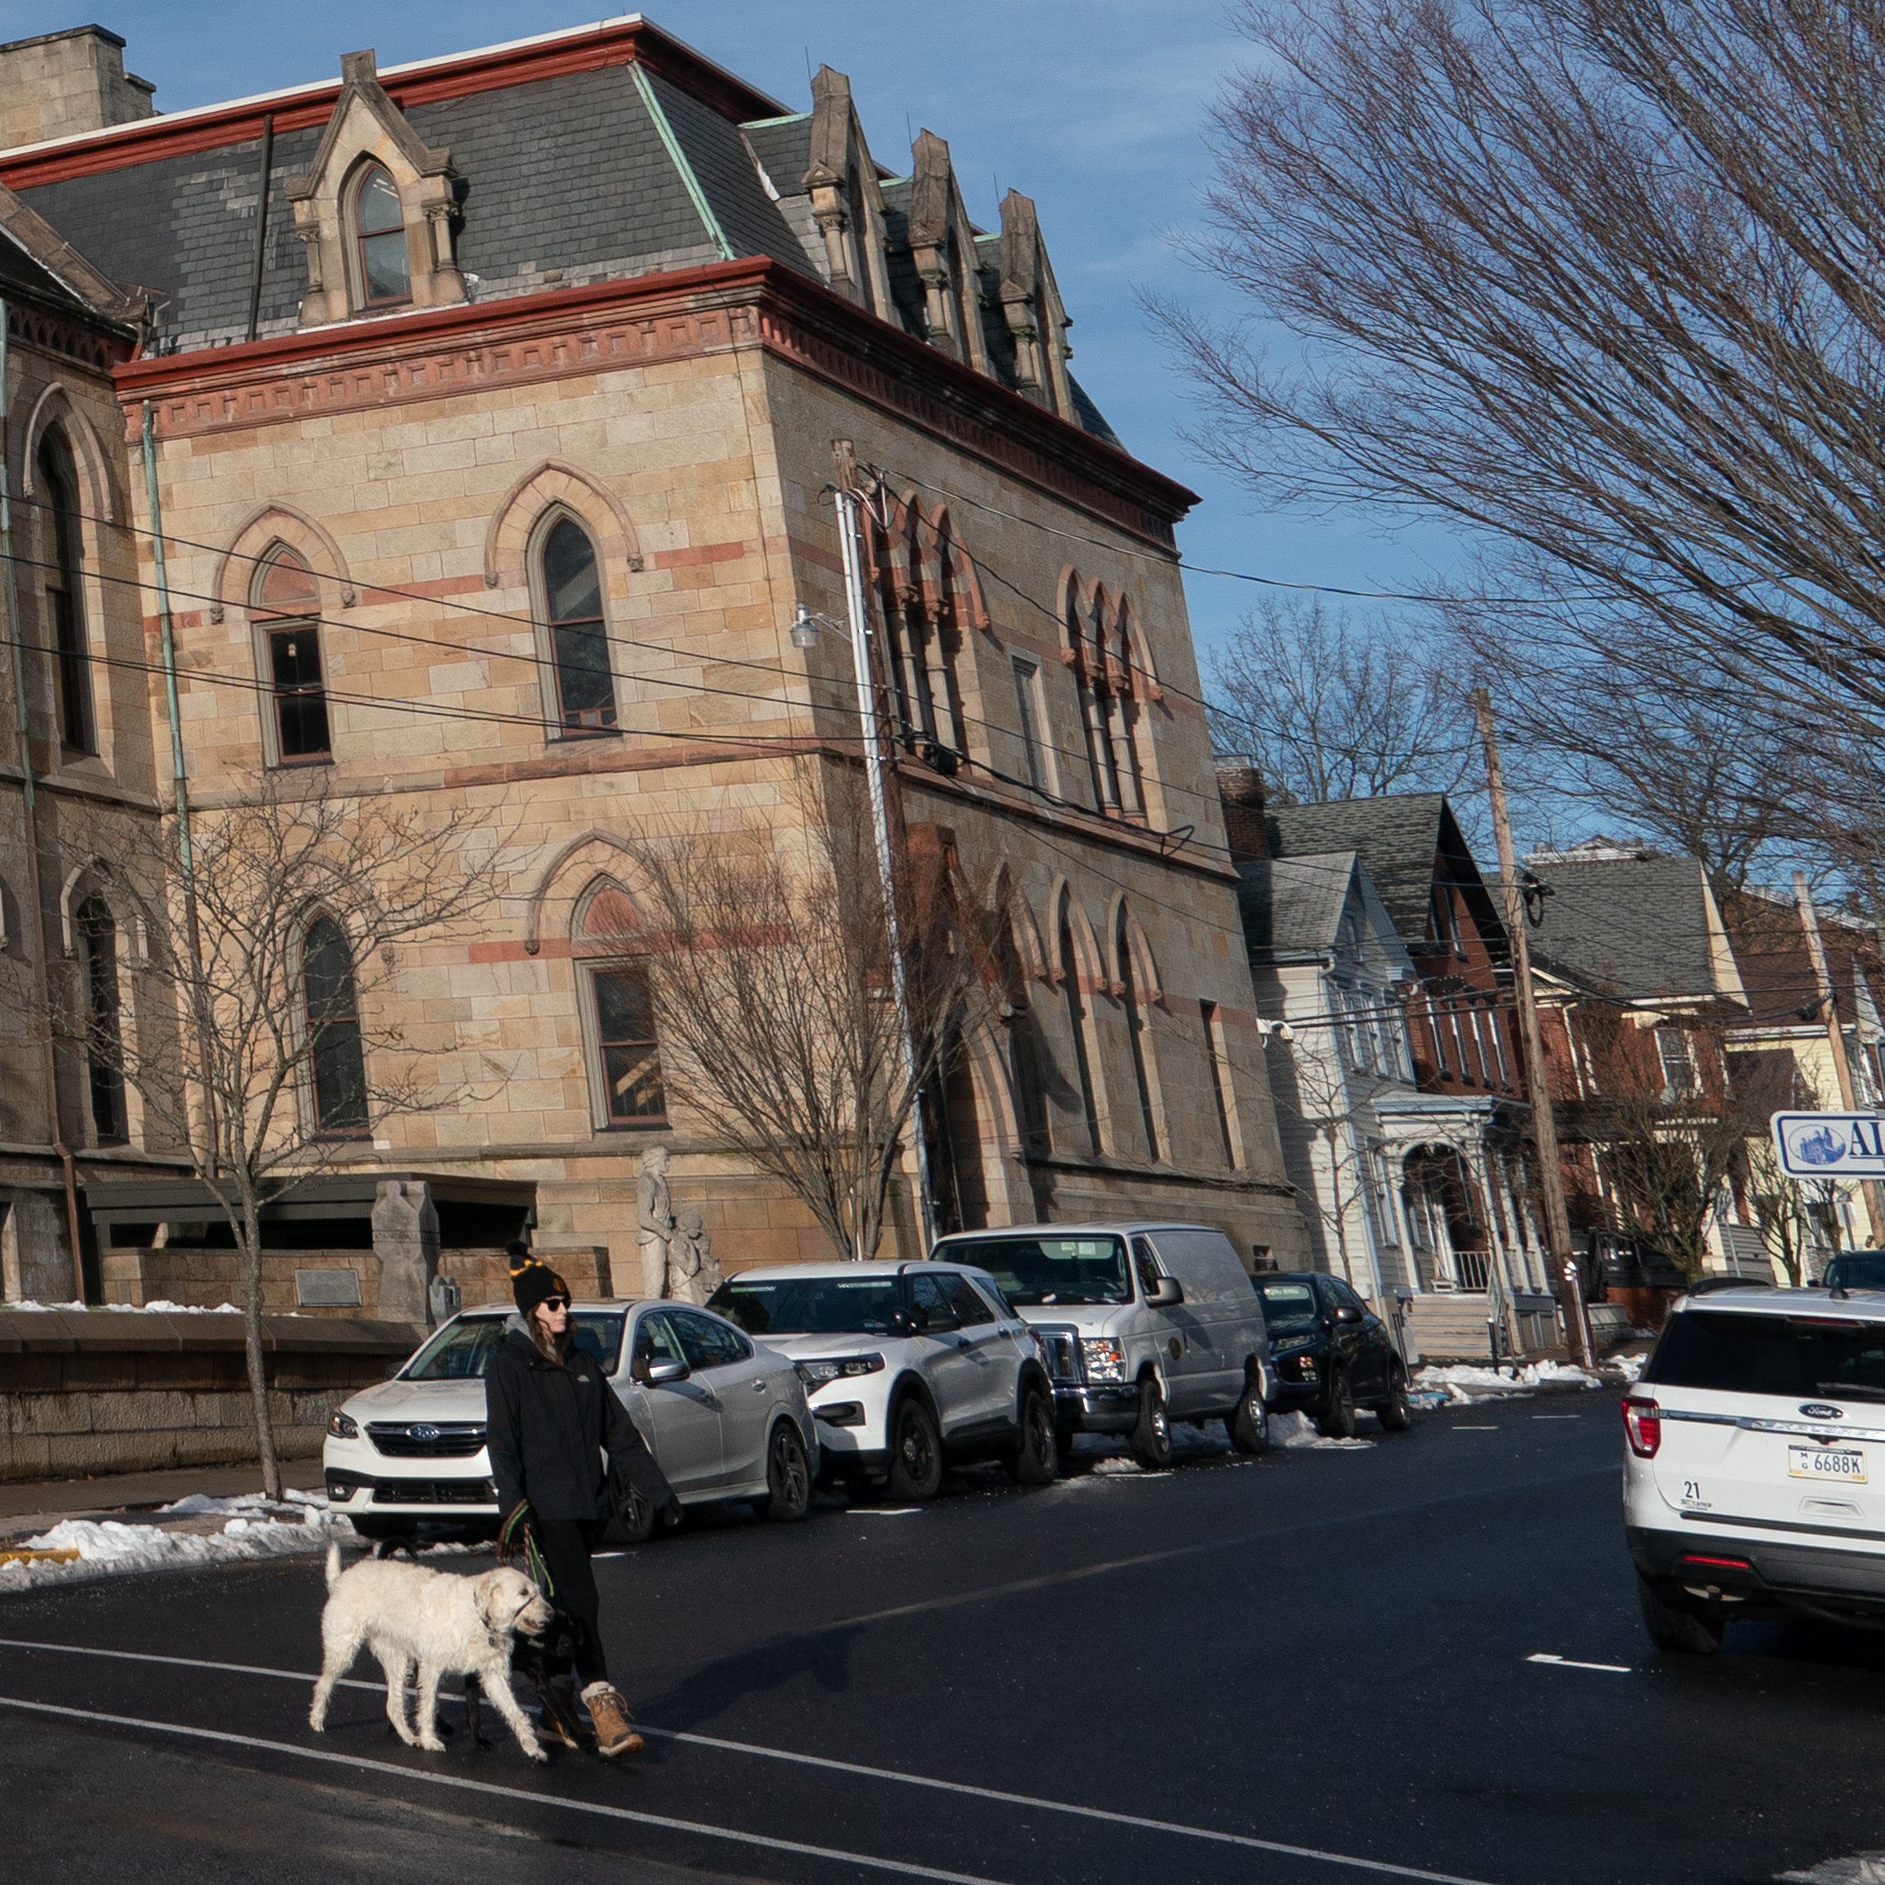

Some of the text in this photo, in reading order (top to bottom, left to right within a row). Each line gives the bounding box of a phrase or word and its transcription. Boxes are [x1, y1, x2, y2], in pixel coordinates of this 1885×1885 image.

[1807, 1406, 1833, 1416] Ford
[1814, 1454, 1861, 1474] 6688K
[1683, 1481, 1700, 1499] 21
